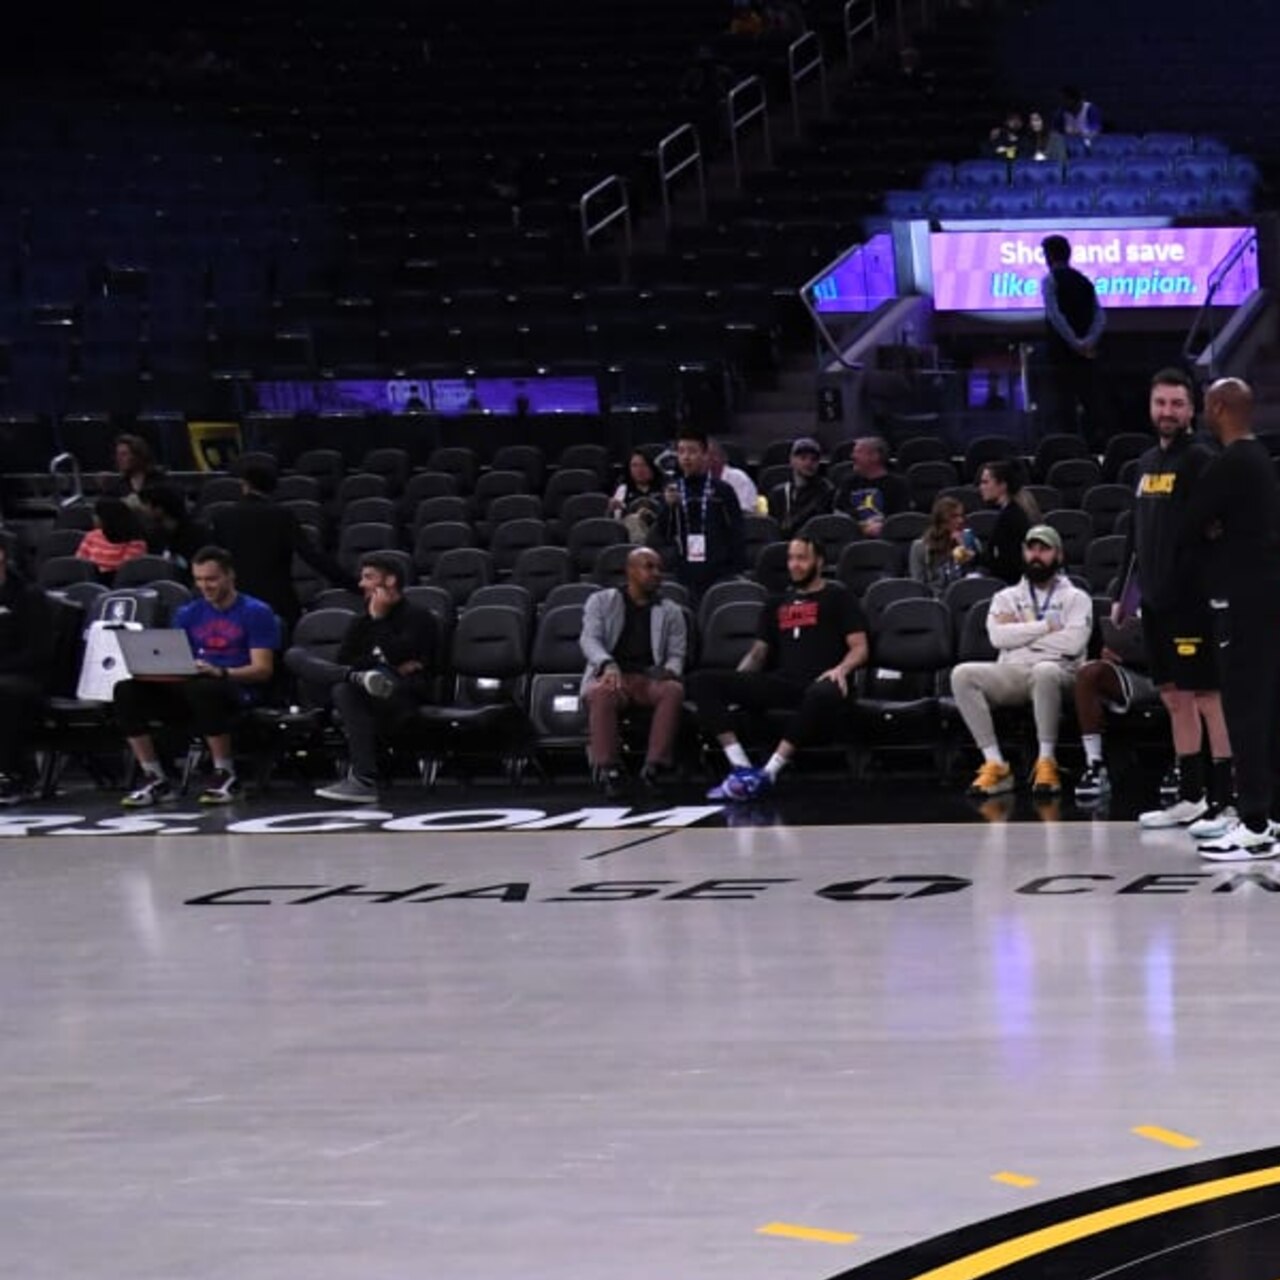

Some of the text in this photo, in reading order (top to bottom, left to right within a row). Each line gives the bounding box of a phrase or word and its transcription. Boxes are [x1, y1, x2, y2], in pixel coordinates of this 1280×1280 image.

[1000, 239, 1185, 264] Sho and save
[992, 269, 1197, 299] like ampion.
[183, 878, 800, 905] CHASE
